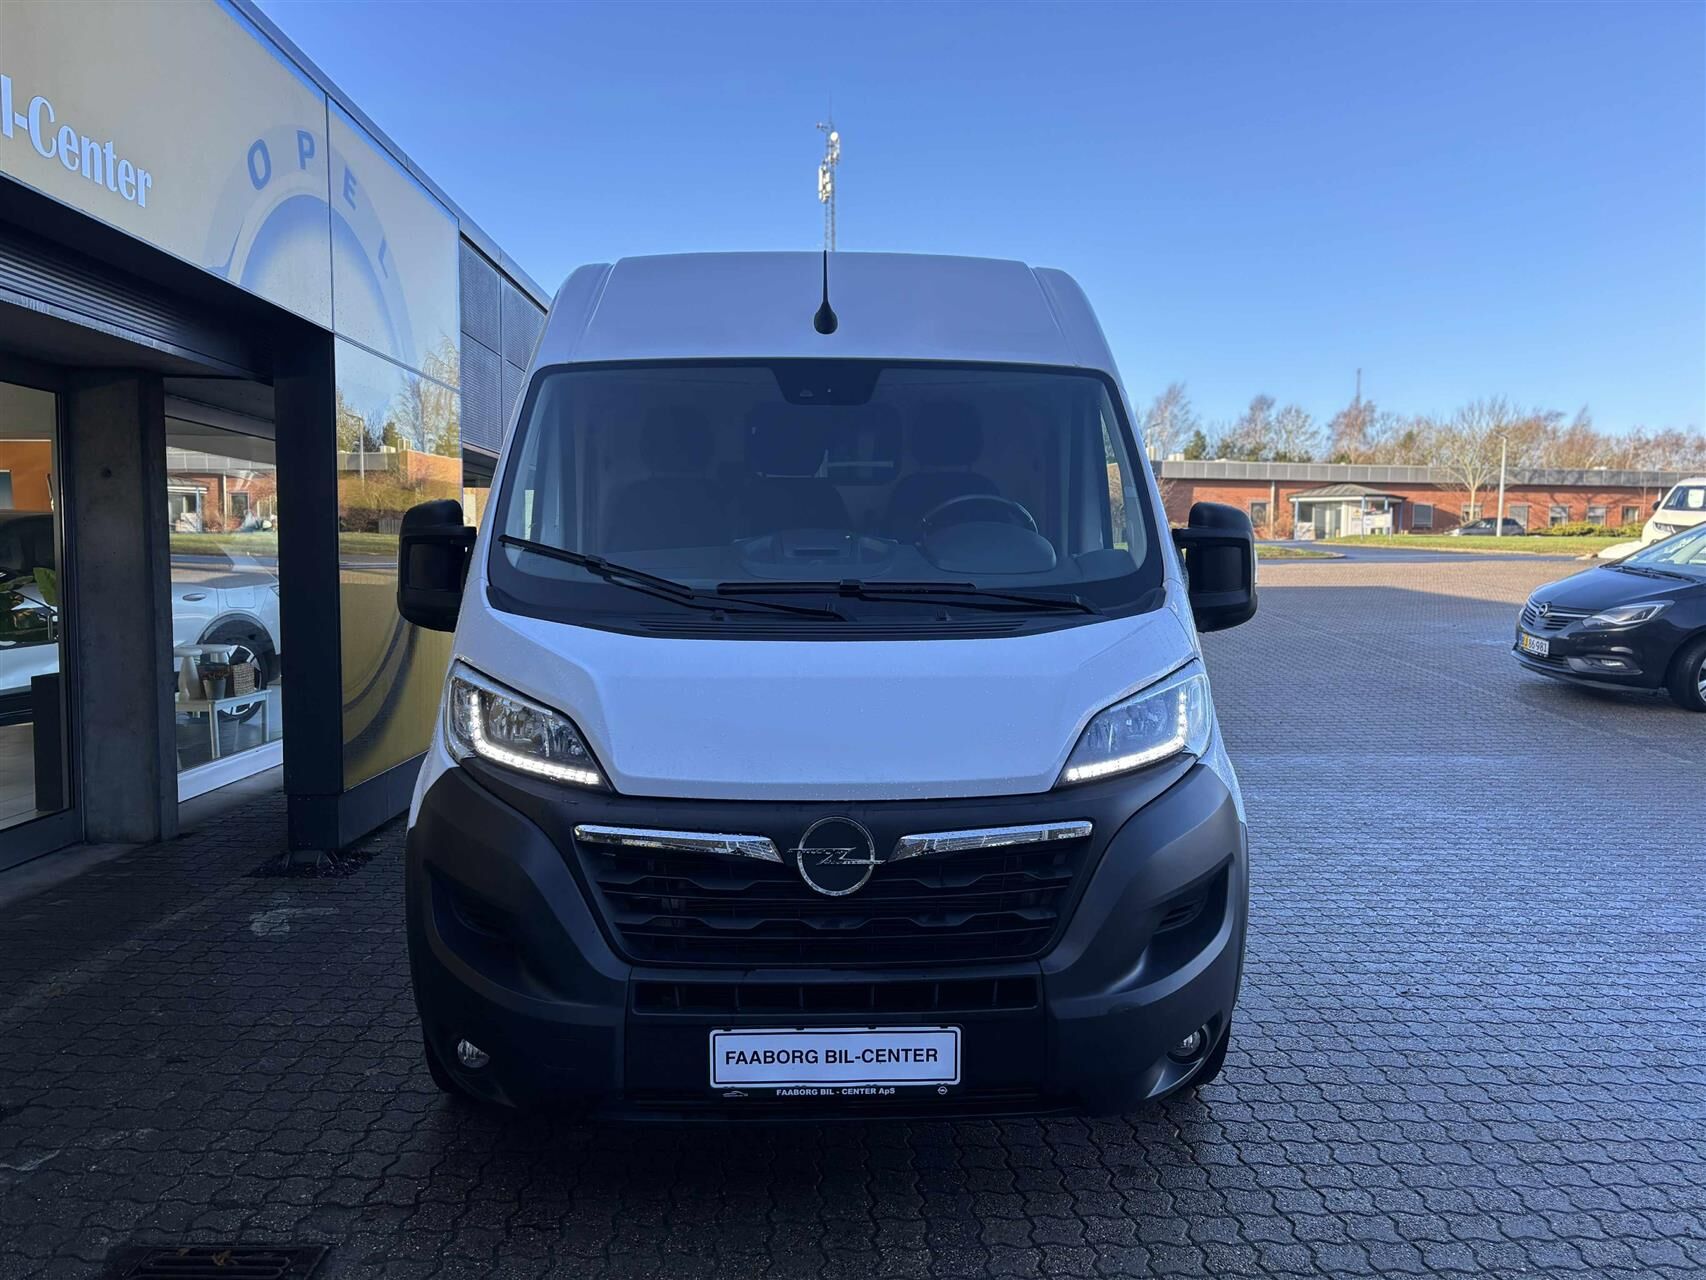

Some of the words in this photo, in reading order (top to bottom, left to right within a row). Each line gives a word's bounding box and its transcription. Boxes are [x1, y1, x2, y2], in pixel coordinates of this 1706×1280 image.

[247, 129, 389, 279] OPEL
[725, 1050, 819, 1065] FAABORG
[825, 1048, 938, 1064] BIL-CENTER
[776, 1088, 818, 1096] FAABORG
[820, 1088, 835, 1096] BIL
[841, 1087, 877, 1096] CENTER
[878, 1087, 896, 1096] ApS
